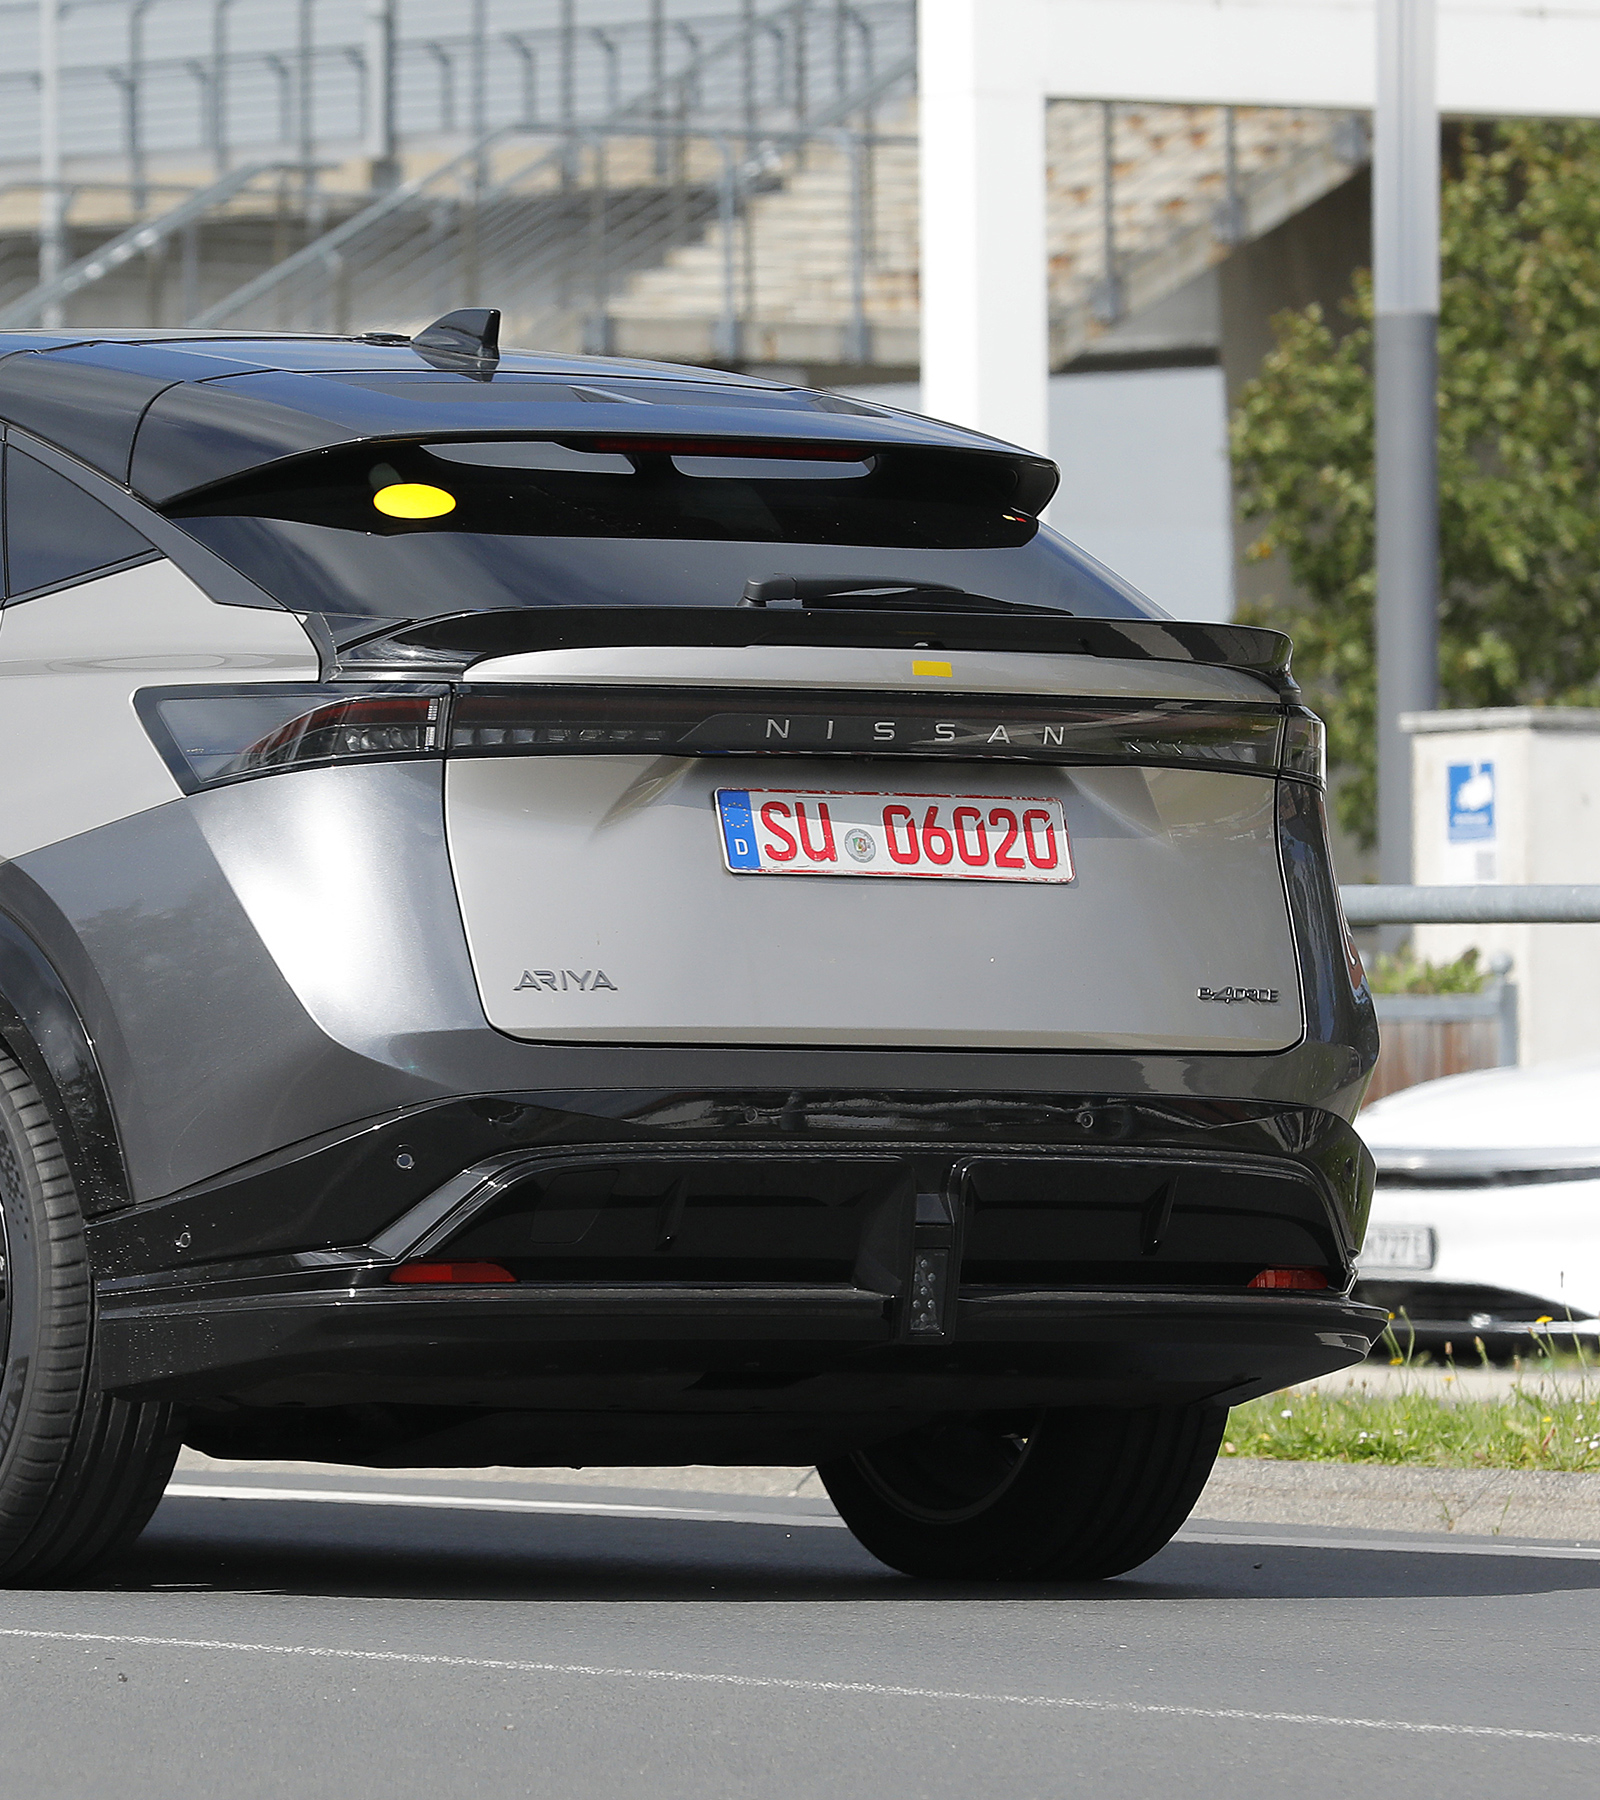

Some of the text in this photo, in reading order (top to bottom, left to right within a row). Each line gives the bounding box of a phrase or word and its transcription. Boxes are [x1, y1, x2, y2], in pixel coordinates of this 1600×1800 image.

[765, 718, 1065, 745] NISSAN
[735, 838, 749, 856] D
[760, 800, 838, 863] SU
[882, 804, 1059, 870] 06020
[512, 969, 618, 991] ARIYA
